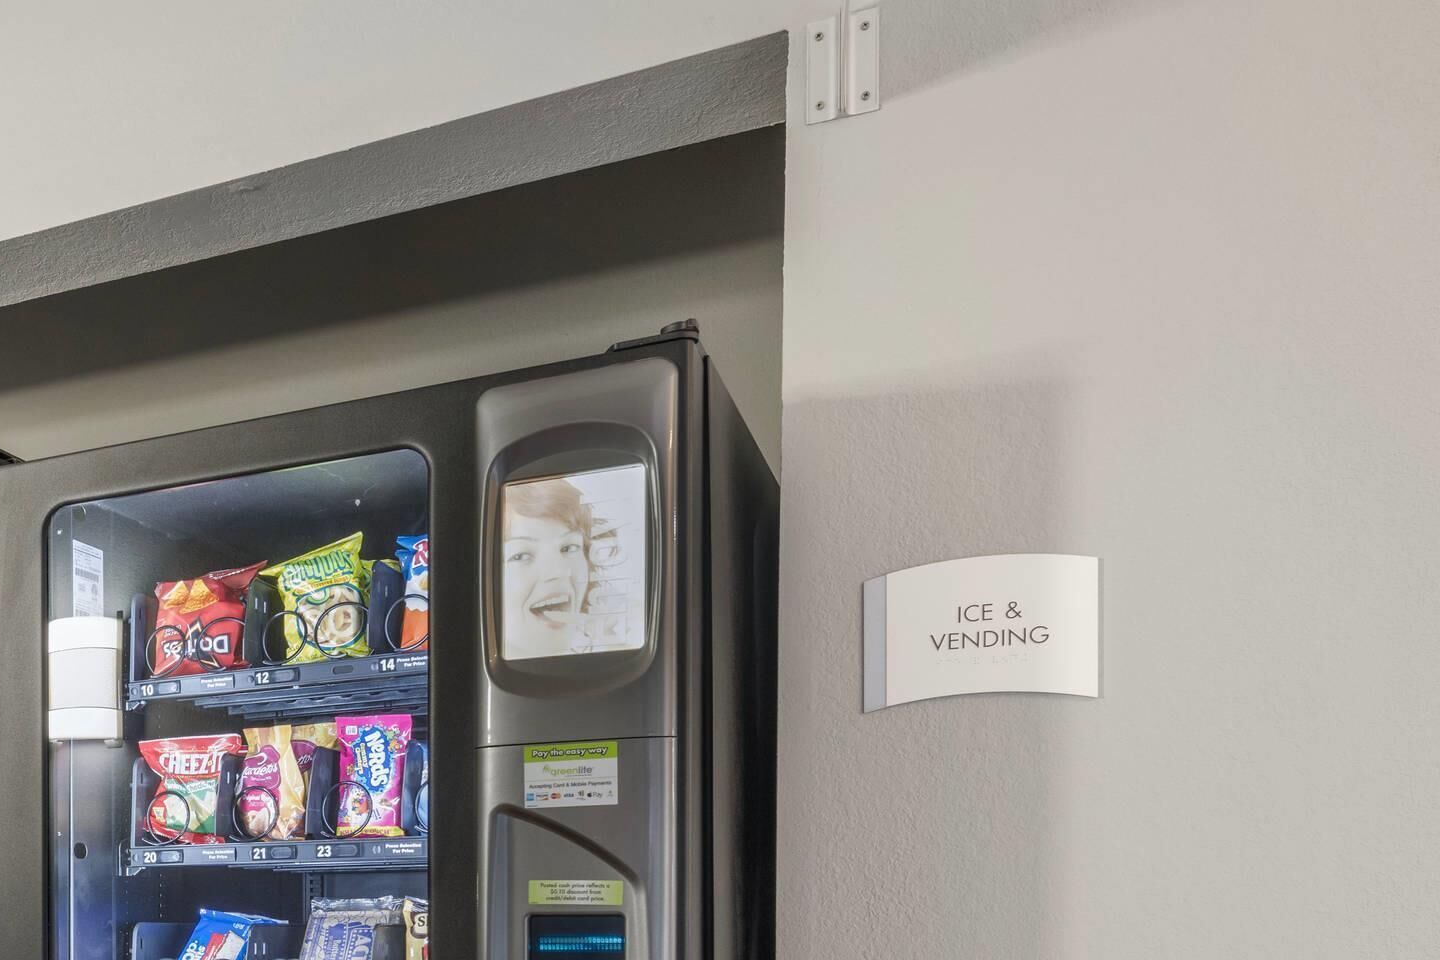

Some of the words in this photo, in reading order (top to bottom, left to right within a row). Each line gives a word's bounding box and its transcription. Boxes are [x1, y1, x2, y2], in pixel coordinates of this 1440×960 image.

[958, 603, 993, 623] ICE
[1005, 601, 1022, 619] &
[930, 625, 1050, 651] VENDING
[380, 658, 396, 672] 14
[255, 672, 270, 684] 12
[141, 684, 154, 696] 10
[532, 750, 548, 758] Pay
[551, 747, 563, 756] the
[566, 747, 586, 756] easy
[588, 746, 608, 755] way
[364, 730, 390, 787] Nerds
[253, 848, 266, 860] 21
[316, 845, 332, 858] 23
[143, 852, 157, 864] 20
